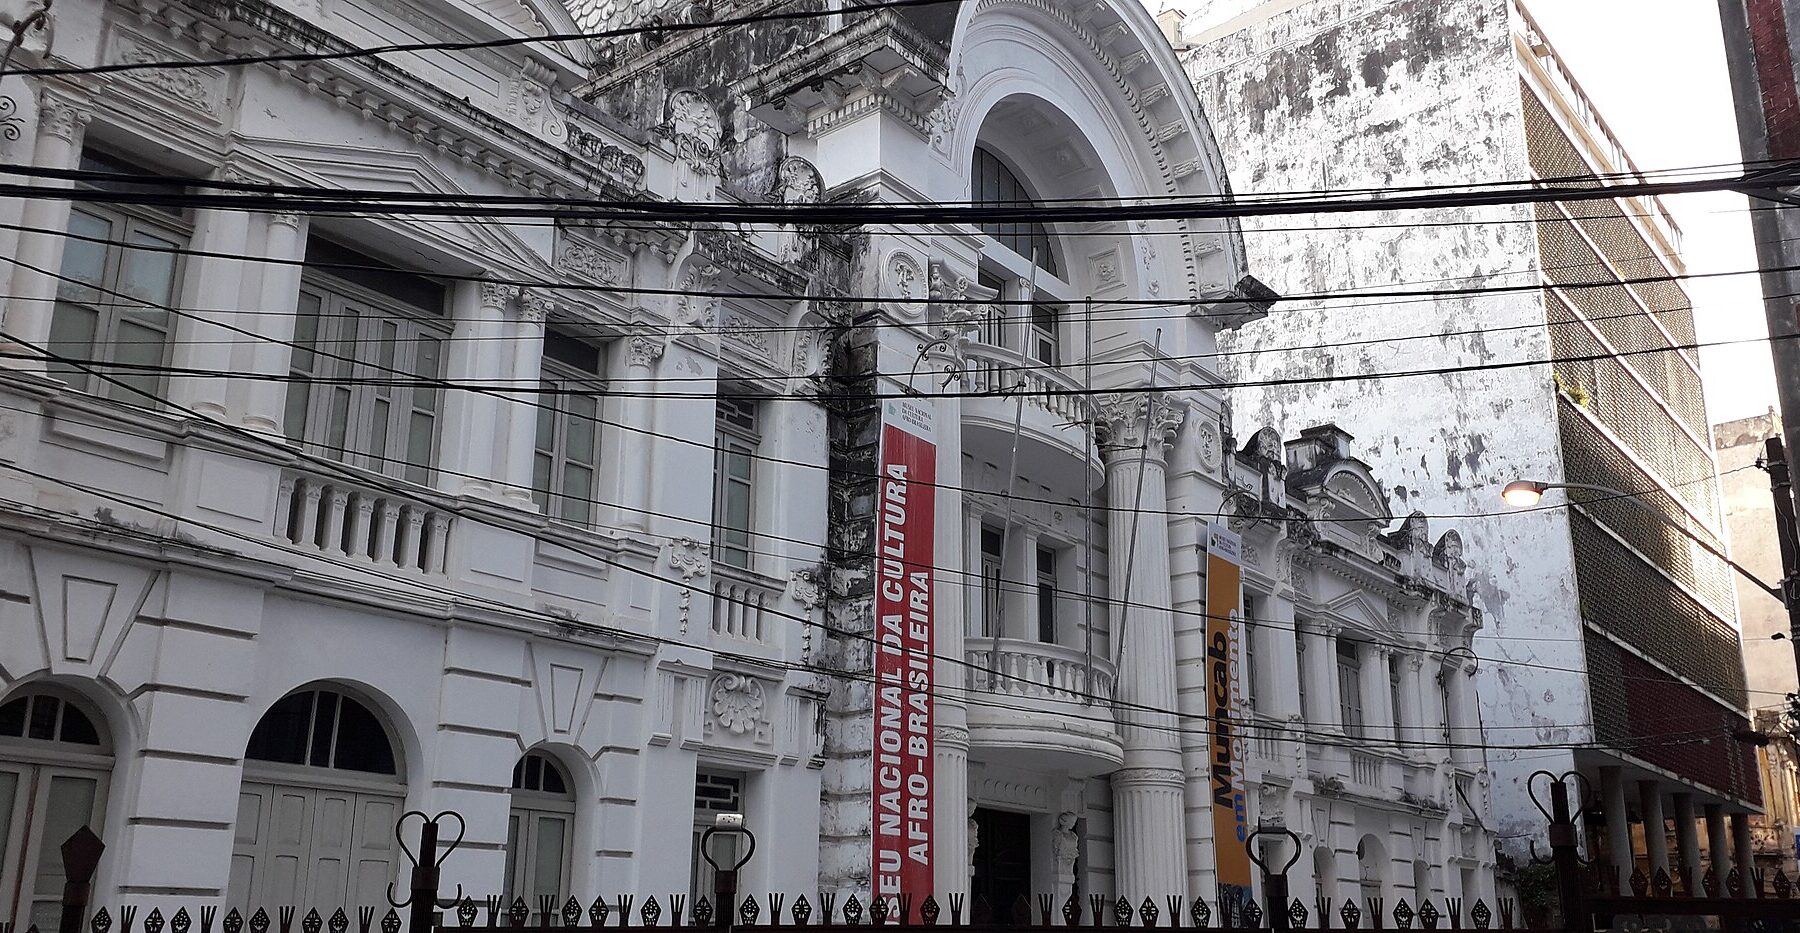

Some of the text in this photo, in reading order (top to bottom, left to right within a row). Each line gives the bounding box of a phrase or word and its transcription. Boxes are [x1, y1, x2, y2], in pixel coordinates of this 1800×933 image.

[882, 464, 908, 603] CULTURA
[881, 614, 903, 656] DA
[908, 572, 929, 865] AFRO-BRASILEIRA
[1208, 631, 1233, 808] Muncab
[879, 667, 902, 836] NACIONAL
[1227, 608, 1247, 843] em Movimento
